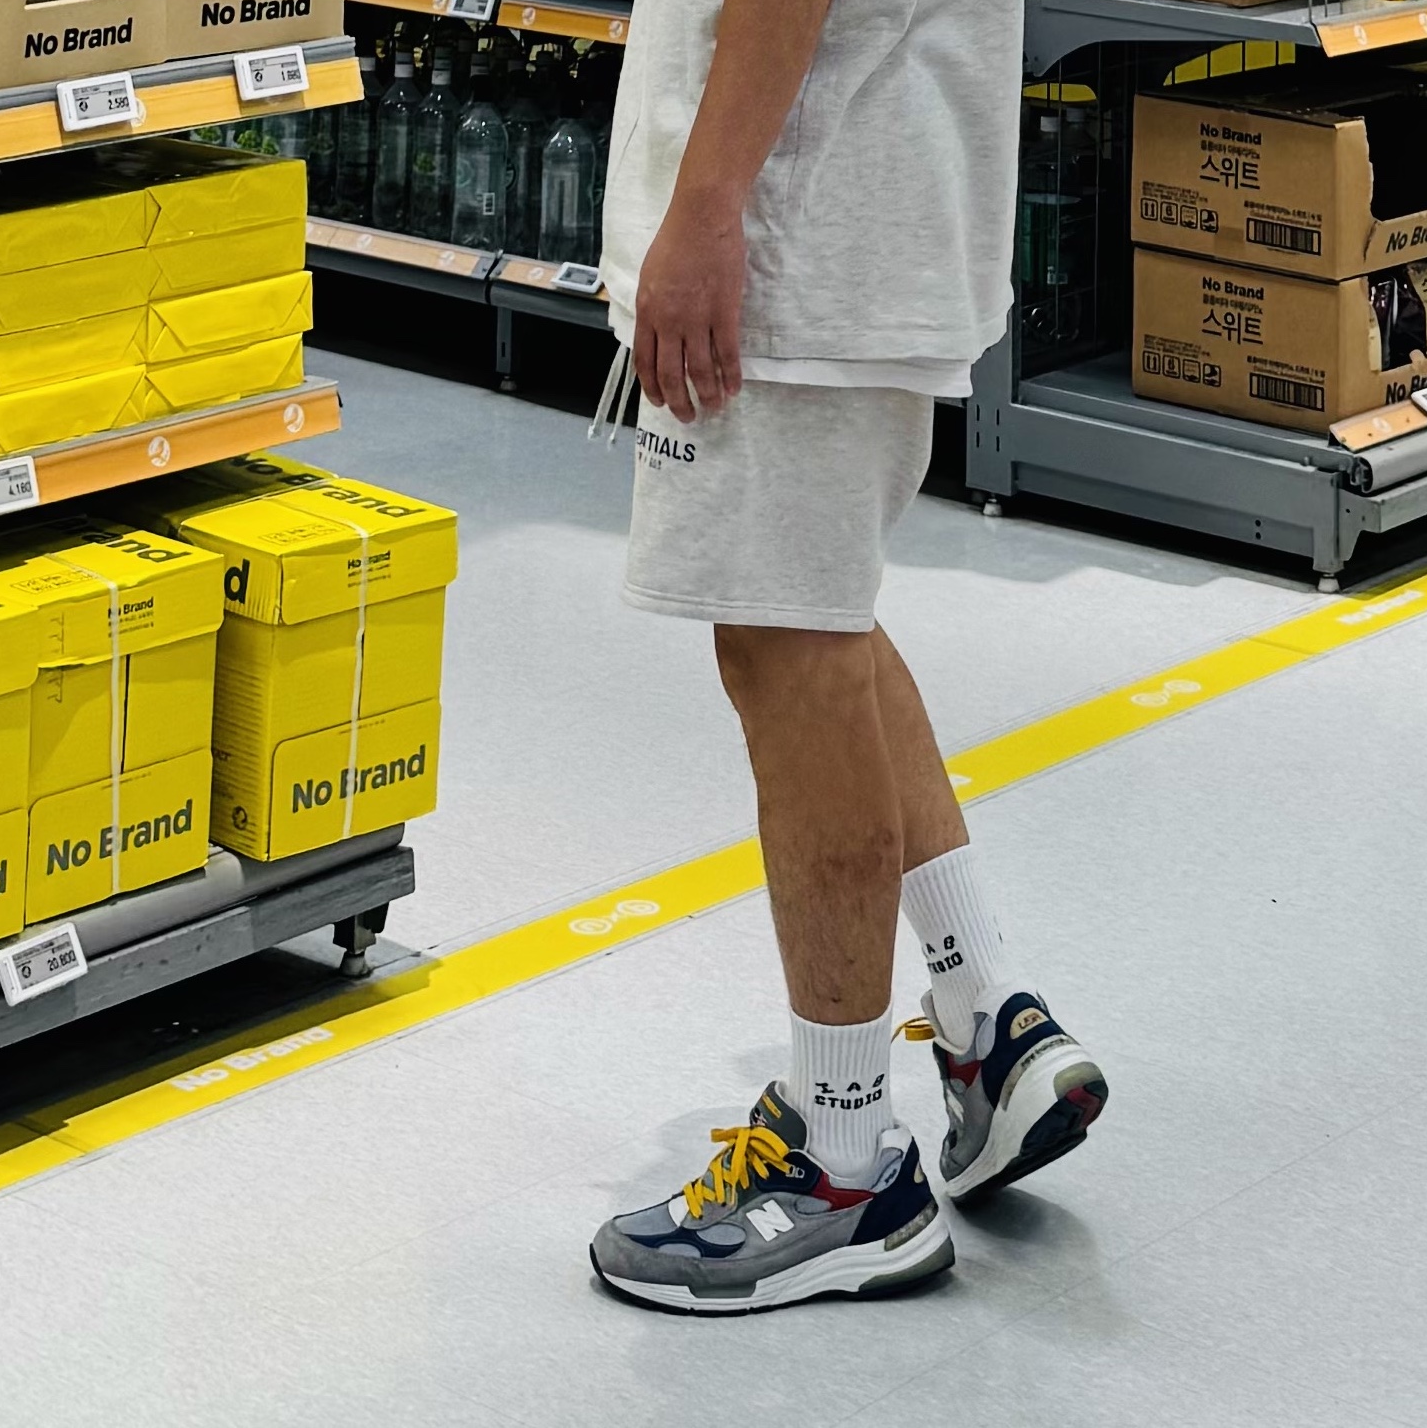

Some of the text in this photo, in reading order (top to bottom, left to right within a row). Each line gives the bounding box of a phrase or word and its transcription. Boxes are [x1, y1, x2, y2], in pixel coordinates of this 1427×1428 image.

[201, 3, 235, 27] No
[25, 17, 133, 58] No Brand
[1199, 156, 1262, 192] 스위트
[1201, 311, 1264, 346] 스위트
[292, 744, 426, 814] No Brand
[46, 799, 193, 876] No Brand
